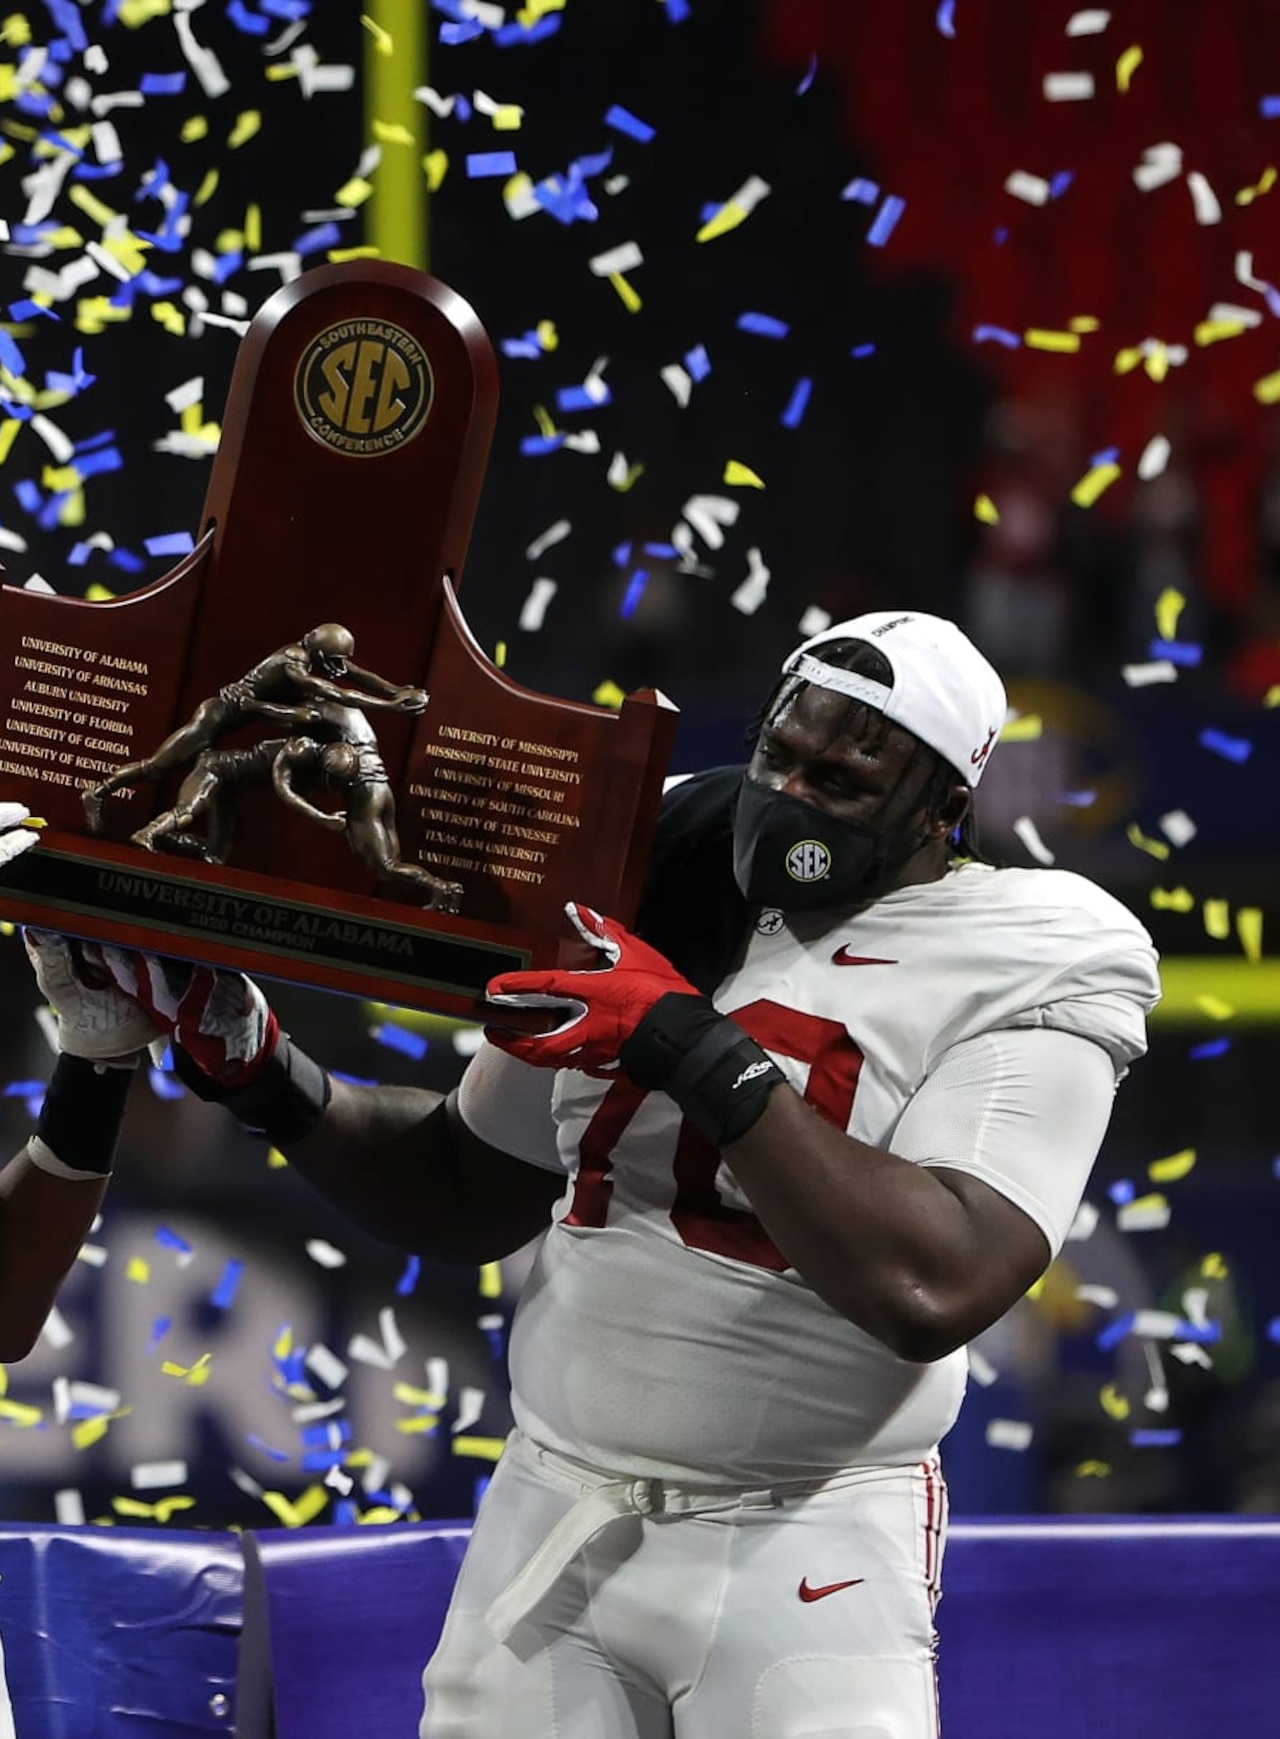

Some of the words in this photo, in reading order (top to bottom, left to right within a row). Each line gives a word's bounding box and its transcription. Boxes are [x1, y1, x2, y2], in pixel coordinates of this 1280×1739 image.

[320, 323, 422, 364] SOUTHEASTERN
[318, 340, 411, 434] SEC
[311, 416, 404, 452] CONFERENCE
[22, 636, 83, 659] UNIVERSITY
[83, 651, 98, 663] OF
[99, 654, 149, 675] ALABAMA
[14, 655, 75, 679] UNIVERSITY
[76, 670, 92, 682] OF
[92, 674, 148, 696] ARKANSAS
[24, 680, 68, 700] AUBURN
[69, 690, 130, 713] UNIVERSITY
[11, 698, 72, 721] UNIVERSITY
[73, 712, 88, 725] OF
[89, 715, 133, 736] FLORIDA
[6, 718, 67, 742] UNIVERSITY
[68, 733, 83, 745] OF
[84, 736, 130, 756] GEORGIA
[438, 725, 500, 747] UNIVERSITY
[501, 737, 517, 750] OF
[518, 741, 579, 763] MISSISSIPPI
[59, 752, 74, 764] OF
[75, 756, 121, 775] KENTUC
[426, 744, 486, 762] MISSISSIPPI
[488, 757, 519, 772] STATE
[521, 762, 583, 785] UNIVERSITY
[41, 769, 73, 787] STATE
[75, 777, 136, 800] UNIITY
[434, 767, 495, 788] UNIVERSITY
[497, 780, 513, 792] OF
[514, 782, 565, 803] MISSOURI
[410, 784, 471, 805] UNIVERSITY
[472, 797, 486, 809] OF
[489, 800, 525, 817] SOUTH
[527, 807, 581, 828] CAROLINA
[421, 807, 482, 829] UNIVERSITY
[484, 820, 498, 832] OF
[501, 823, 560, 845] TENNESSEE
[425, 830, 457, 845] TEXAS
[485, 842, 548, 864] UNIVERSITY
[789, 843, 829, 879] SEC
[419, 849, 481, 872] VANDERBILT
[483, 863, 545, 885] UNIVERSITY
[97, 870, 246, 922] UNIVERSITY
[254, 904, 290, 928] OF
[294, 915, 414, 956] ALABAMA
[189, 912, 230, 933] 2020
[232, 922, 316, 950] CHAMPION
